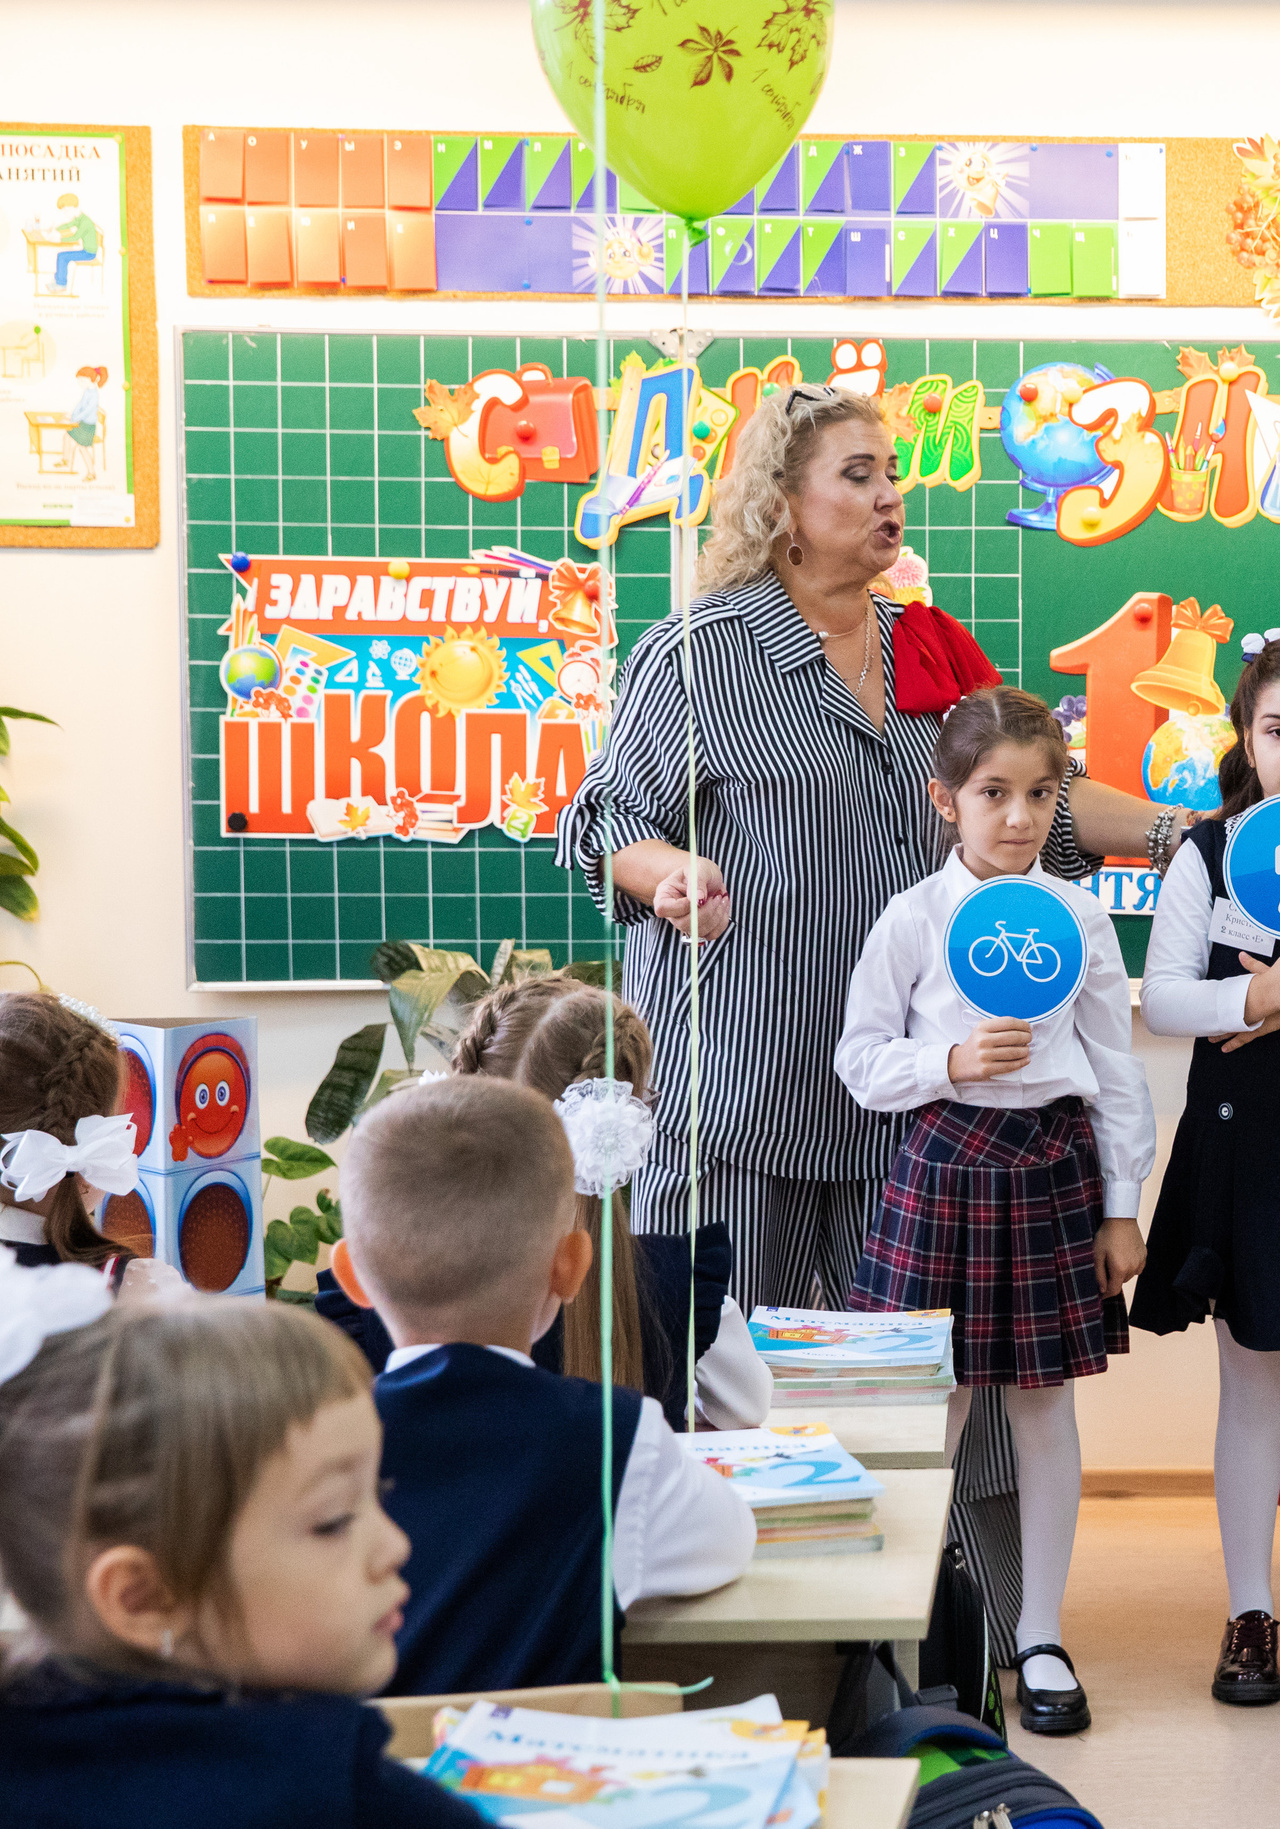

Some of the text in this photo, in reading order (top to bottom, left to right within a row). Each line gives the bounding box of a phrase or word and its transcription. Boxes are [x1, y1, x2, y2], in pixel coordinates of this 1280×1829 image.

[1, 144, 102, 160] ПОСАДКА
[0, 166, 81, 182] НЯТИЙ
[221, 689, 588, 837] ШКОЛА
[1228, 928, 1250, 940] класс
[873, 1334, 938, 1353] 2
[768, 1460, 862, 1488] 2
